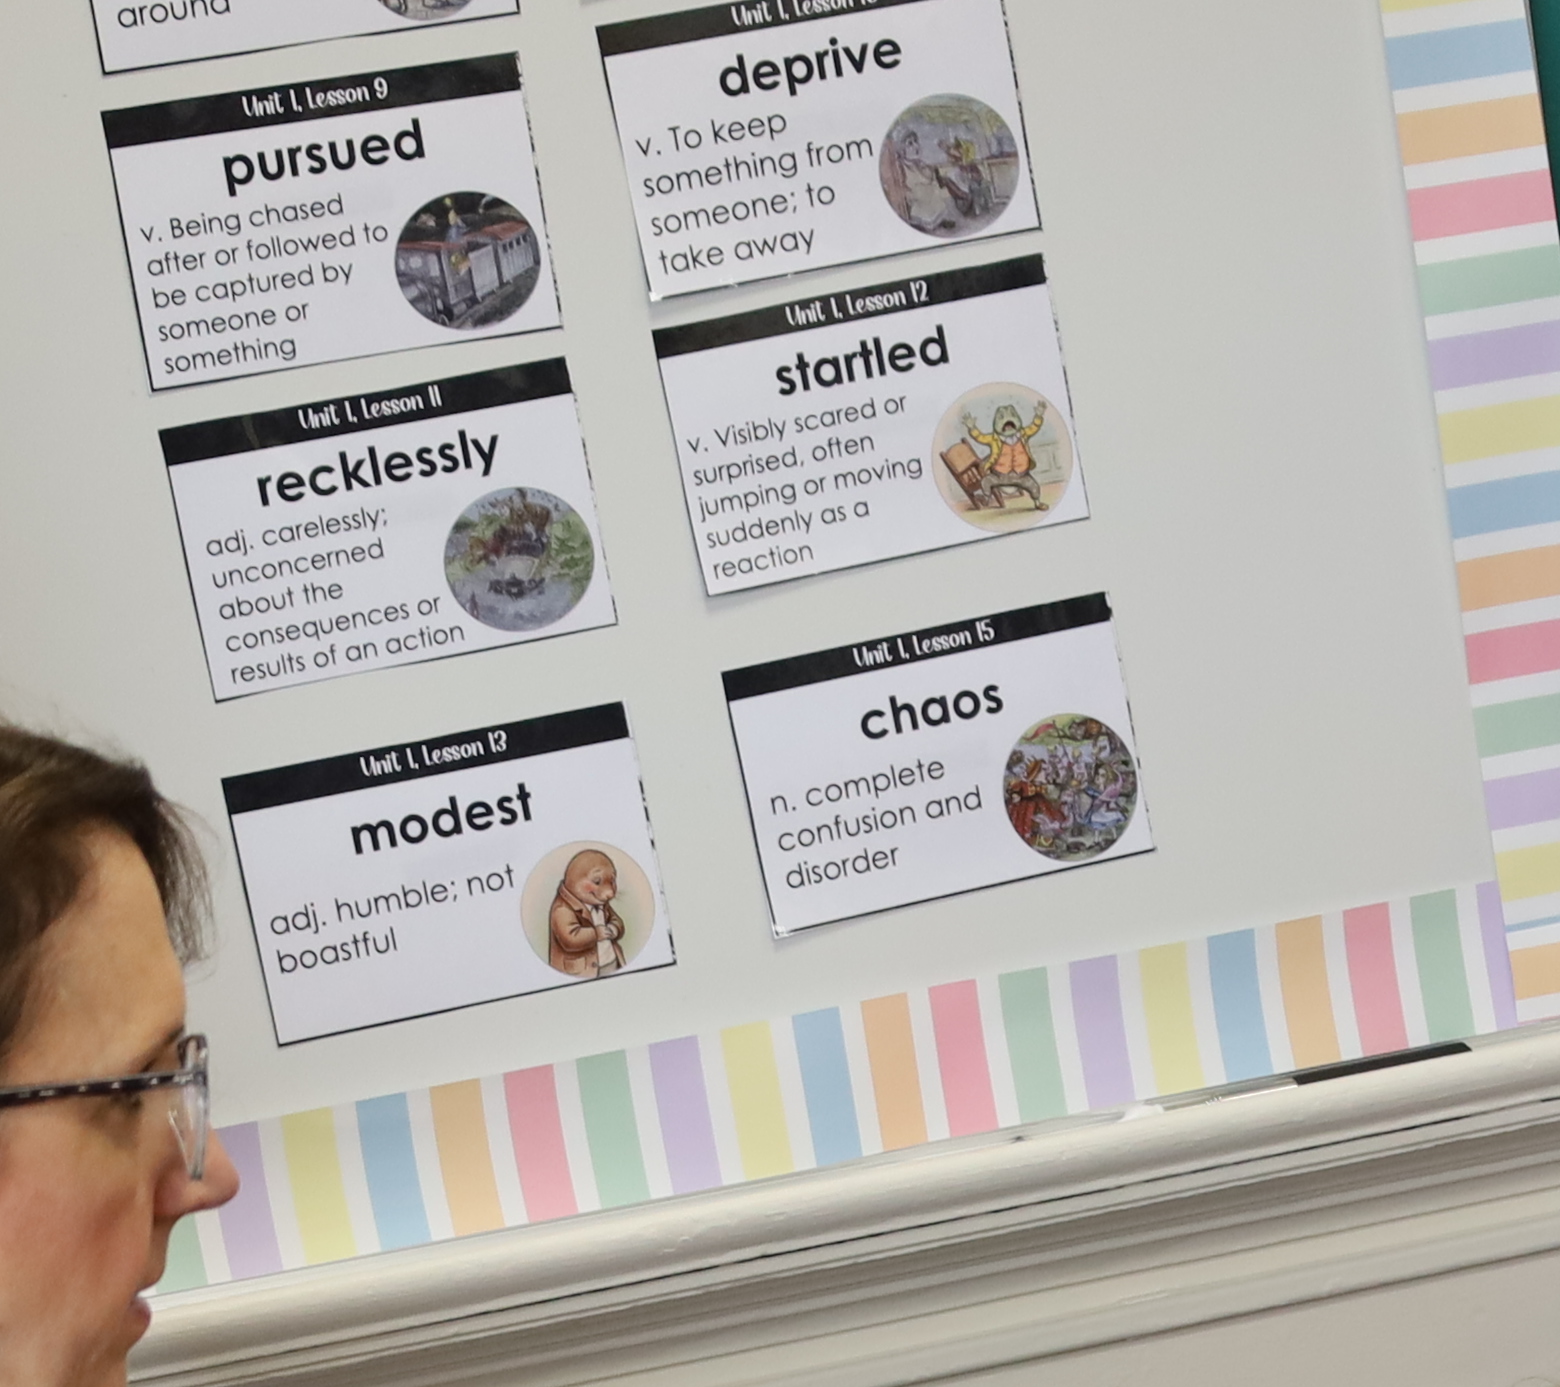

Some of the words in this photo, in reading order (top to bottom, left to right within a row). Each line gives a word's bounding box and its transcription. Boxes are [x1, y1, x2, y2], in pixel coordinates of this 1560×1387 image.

[116, 0, 233, 29] around
[730, 0, 773, 27] Unit
[718, 35, 902, 97] deprive
[240, 90, 284, 117] Unit
[288, 87, 303, 113] 1,
[304, 85, 370, 109] Lesson
[372, 76, 388, 100] 9
[221, 116, 426, 198] pursued
[634, 136, 662, 157] v.
[666, 124, 703, 152] To
[709, 112, 787, 145] keep
[642, 150, 798, 198] something
[804, 137, 874, 168] from
[138, 225, 163, 243] v.
[168, 211, 242, 240] Being
[247, 191, 344, 228] chased
[650, 190, 797, 237] someone;
[804, 181, 836, 208] to
[145, 250, 206, 277] after
[213, 245, 239, 267] or
[245, 223, 356, 262] followed
[361, 221, 389, 244] to
[658, 243, 724, 275] take
[733, 227, 814, 261] away
[150, 286, 187, 309] be
[193, 262, 315, 303] captured
[320, 260, 353, 286] by
[783, 299, 826, 326] Unit
[828, 296, 844, 319] 1,
[844, 289, 907, 316] Lesson
[908, 279, 928, 303] 12
[157, 307, 277, 342] someone
[283, 302, 309, 323] or
[163, 336, 297, 375] something
[774, 323, 950, 396] startled
[298, 401, 340, 430] Unit
[344, 400, 358, 425] 1,
[360, 394, 426, 421] Lesson
[426, 384, 444, 408] 11
[685, 436, 709, 454] v.
[712, 416, 786, 448] Visibly
[793, 396, 877, 434] scared
[882, 394, 906, 415] or
[255, 428, 499, 507] recklessly
[692, 444, 804, 487] surprised,
[810, 434, 875, 462] often
[697, 482, 797, 523] jumping
[802, 475, 826, 496] or
[832, 456, 923, 490] moving
[204, 527, 254, 557] adj.
[260, 505, 388, 547] carelessly;
[705, 508, 813, 549] suddenly
[819, 504, 847, 525] as
[852, 500, 870, 518] a
[210, 536, 385, 589] unconcerned
[712, 544, 814, 580] reaction
[217, 585, 294, 620] about
[301, 581, 343, 605] the
[224, 602, 410, 653] consequences
[416, 595, 441, 616] or
[229, 651, 306, 684] results
[312, 642, 337, 669] of
[344, 641, 378, 662] an
[384, 624, 465, 655] action
[851, 640, 893, 667] Unit
[895, 636, 910, 660] 1,
[911, 629, 973, 656] Lesson
[974, 618, 995, 642] 15
[859, 683, 1004, 740] chaos
[358, 750, 402, 777] Unit
[404, 746, 419, 770] 1,
[420, 740, 485, 766] Lesson
[486, 729, 507, 753] 13
[769, 794, 797, 815] n.
[804, 757, 945, 807] complete
[349, 781, 532, 855] modest
[776, 804, 917, 852] confusion
[924, 783, 983, 820] and
[784, 846, 899, 889] disorder
[268, 901, 327, 936] adj.
[333, 879, 458, 923] humble;
[465, 862, 514, 896] not
[274, 925, 398, 975] boastful
